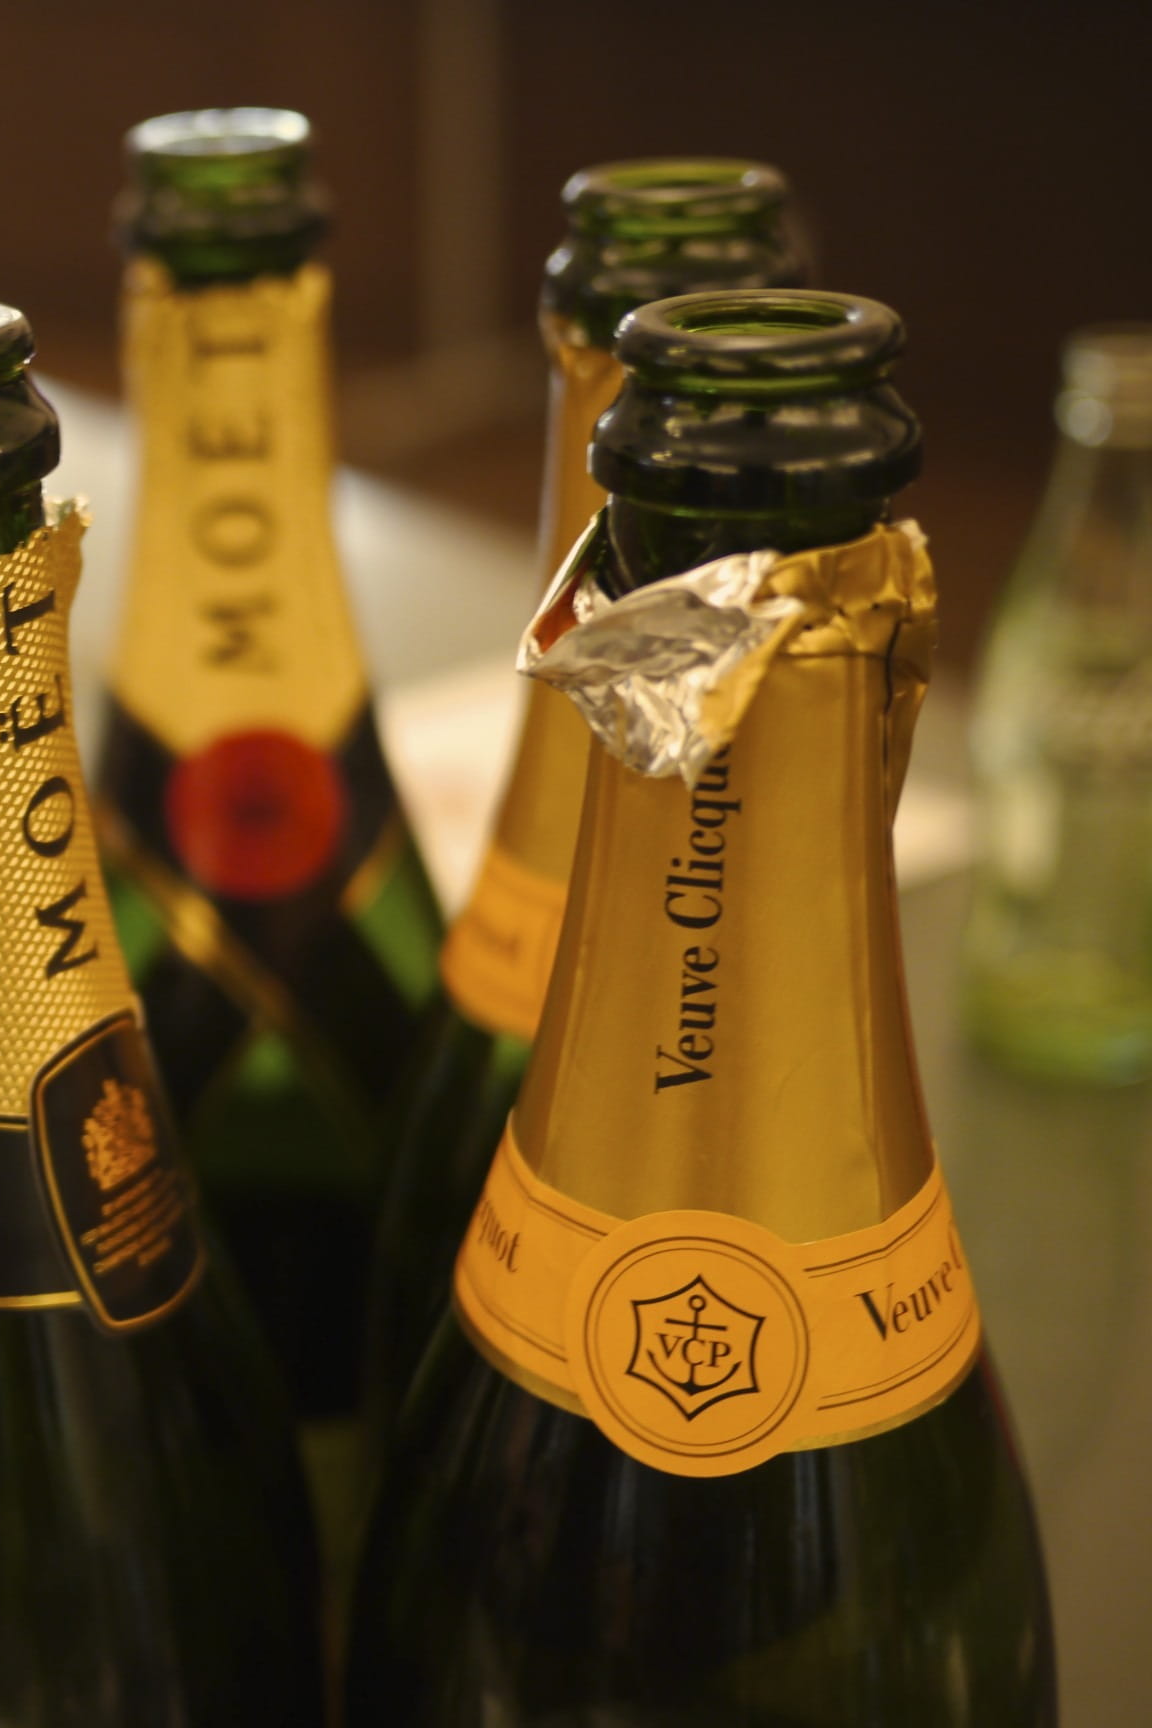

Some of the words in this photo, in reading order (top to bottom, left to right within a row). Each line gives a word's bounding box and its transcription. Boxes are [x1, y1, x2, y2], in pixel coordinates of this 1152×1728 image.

[653, 945, 721, 1095] Veuve
[852, 1261, 953, 1342] Veuve
[653, 1332, 732, 1369] VCP
